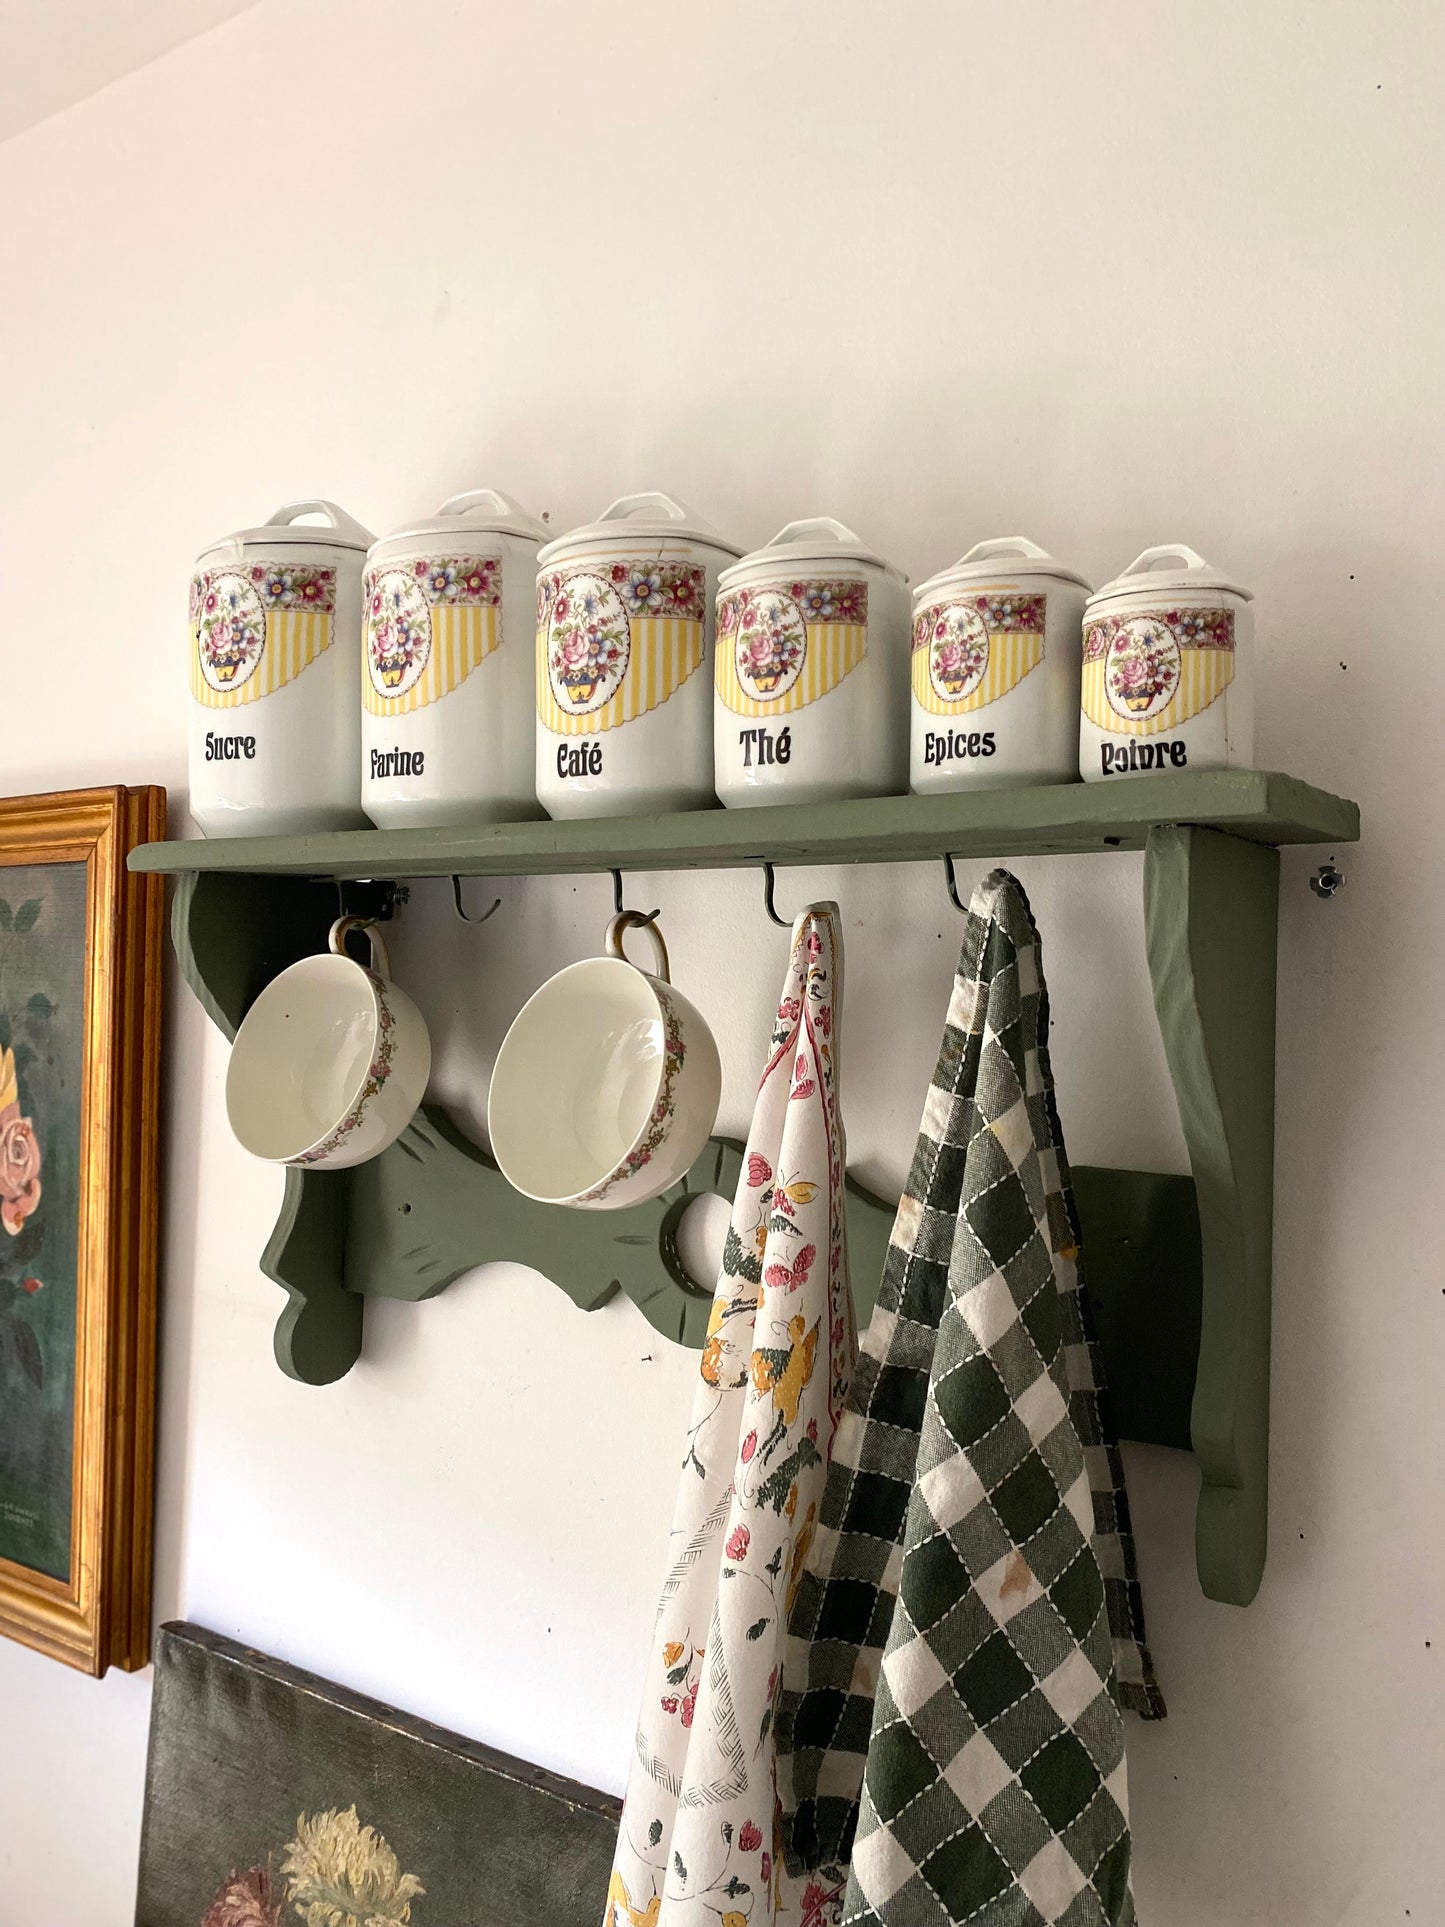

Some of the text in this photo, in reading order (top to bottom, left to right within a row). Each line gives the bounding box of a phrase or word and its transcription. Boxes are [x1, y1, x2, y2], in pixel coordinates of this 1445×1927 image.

[205, 731, 255, 761] Sucre
[370, 746, 424, 780] Farine
[556, 741, 602, 779] Café
[739, 726, 791, 766] Thé
[924, 729, 996, 766] Epices
[1101, 739, 1187, 775] Poivre
